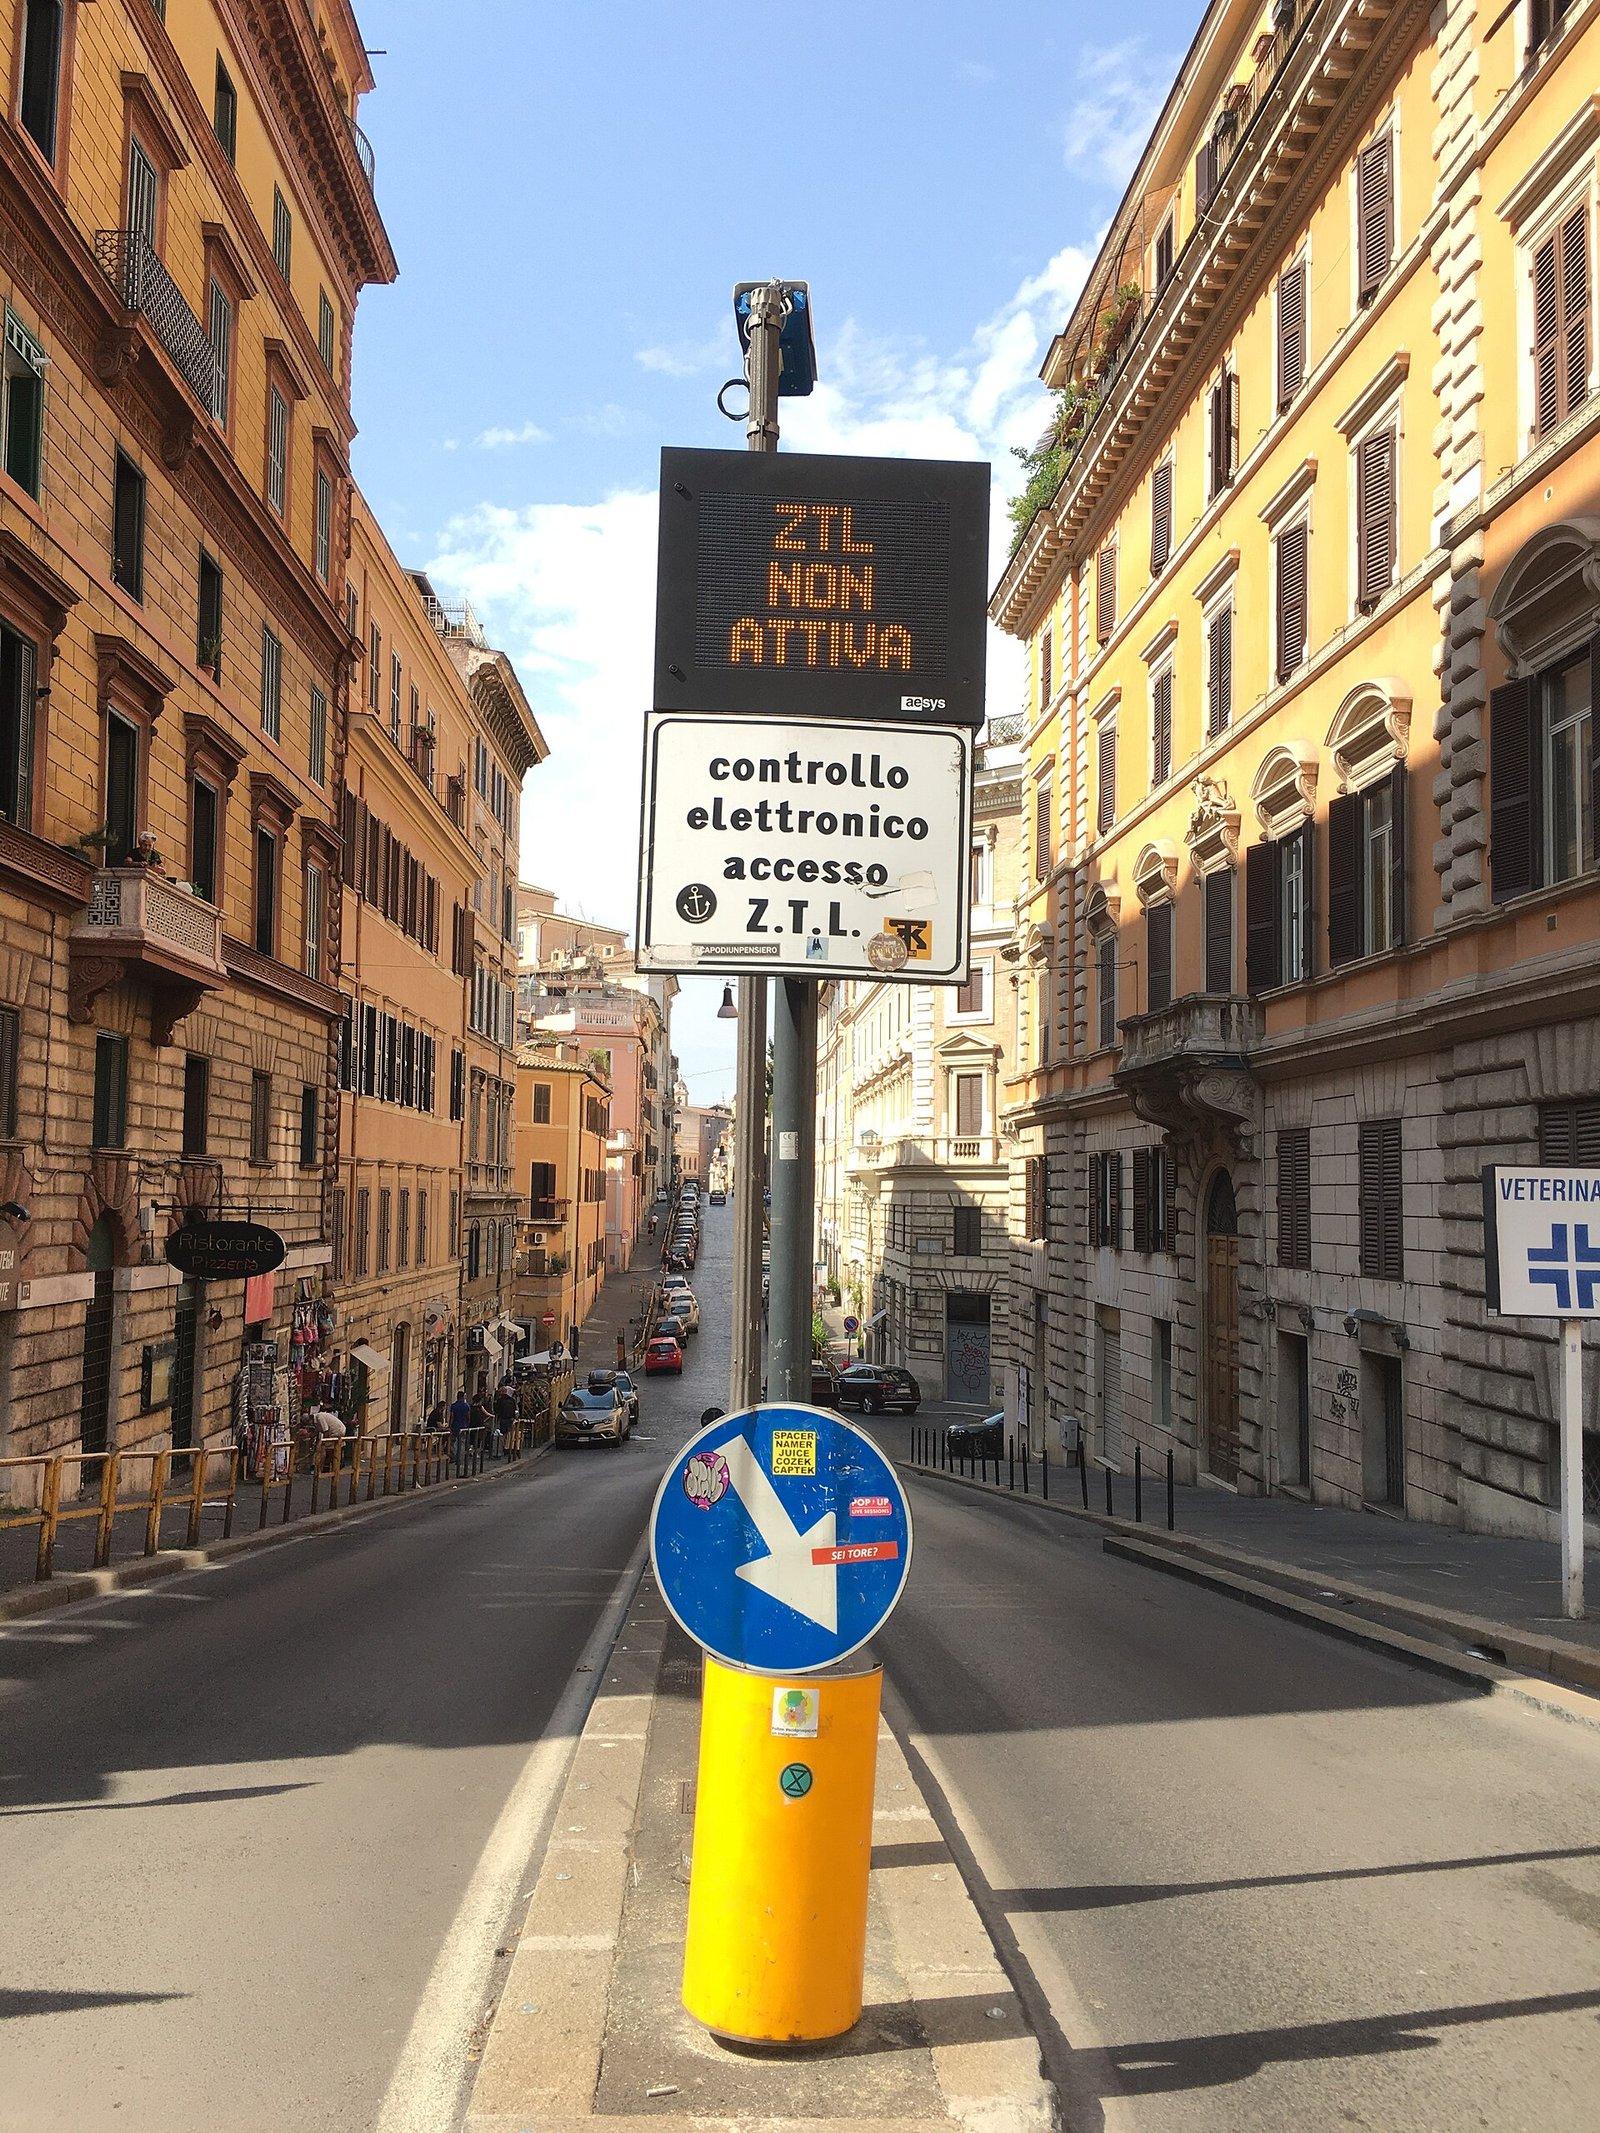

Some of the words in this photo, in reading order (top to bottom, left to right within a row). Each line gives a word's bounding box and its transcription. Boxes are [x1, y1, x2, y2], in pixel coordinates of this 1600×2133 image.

[775, 504, 874, 553] ZTL
[768, 561, 874, 611] NON
[730, 617, 912, 670] ATTIVA
[905, 698, 946, 711] aesys
[709, 751, 909, 789] controllo
[687, 797, 929, 841] elettronico
[723, 856, 888, 886] accesso
[746, 898, 861, 937] Z.T.L.
[179, 1232, 273, 1252] Ristorante
[774, 1431, 814, 1440] SPACER
[775, 1440, 813, 1448] NAMER
[776, 1457, 811, 1466] COZEK
[778, 1449, 810, 1457] JUICE
[773, 1466, 815, 1474] CAPTEK
[831, 1551, 846, 1561] SEI
[847, 1546, 878, 1559] TORE?
